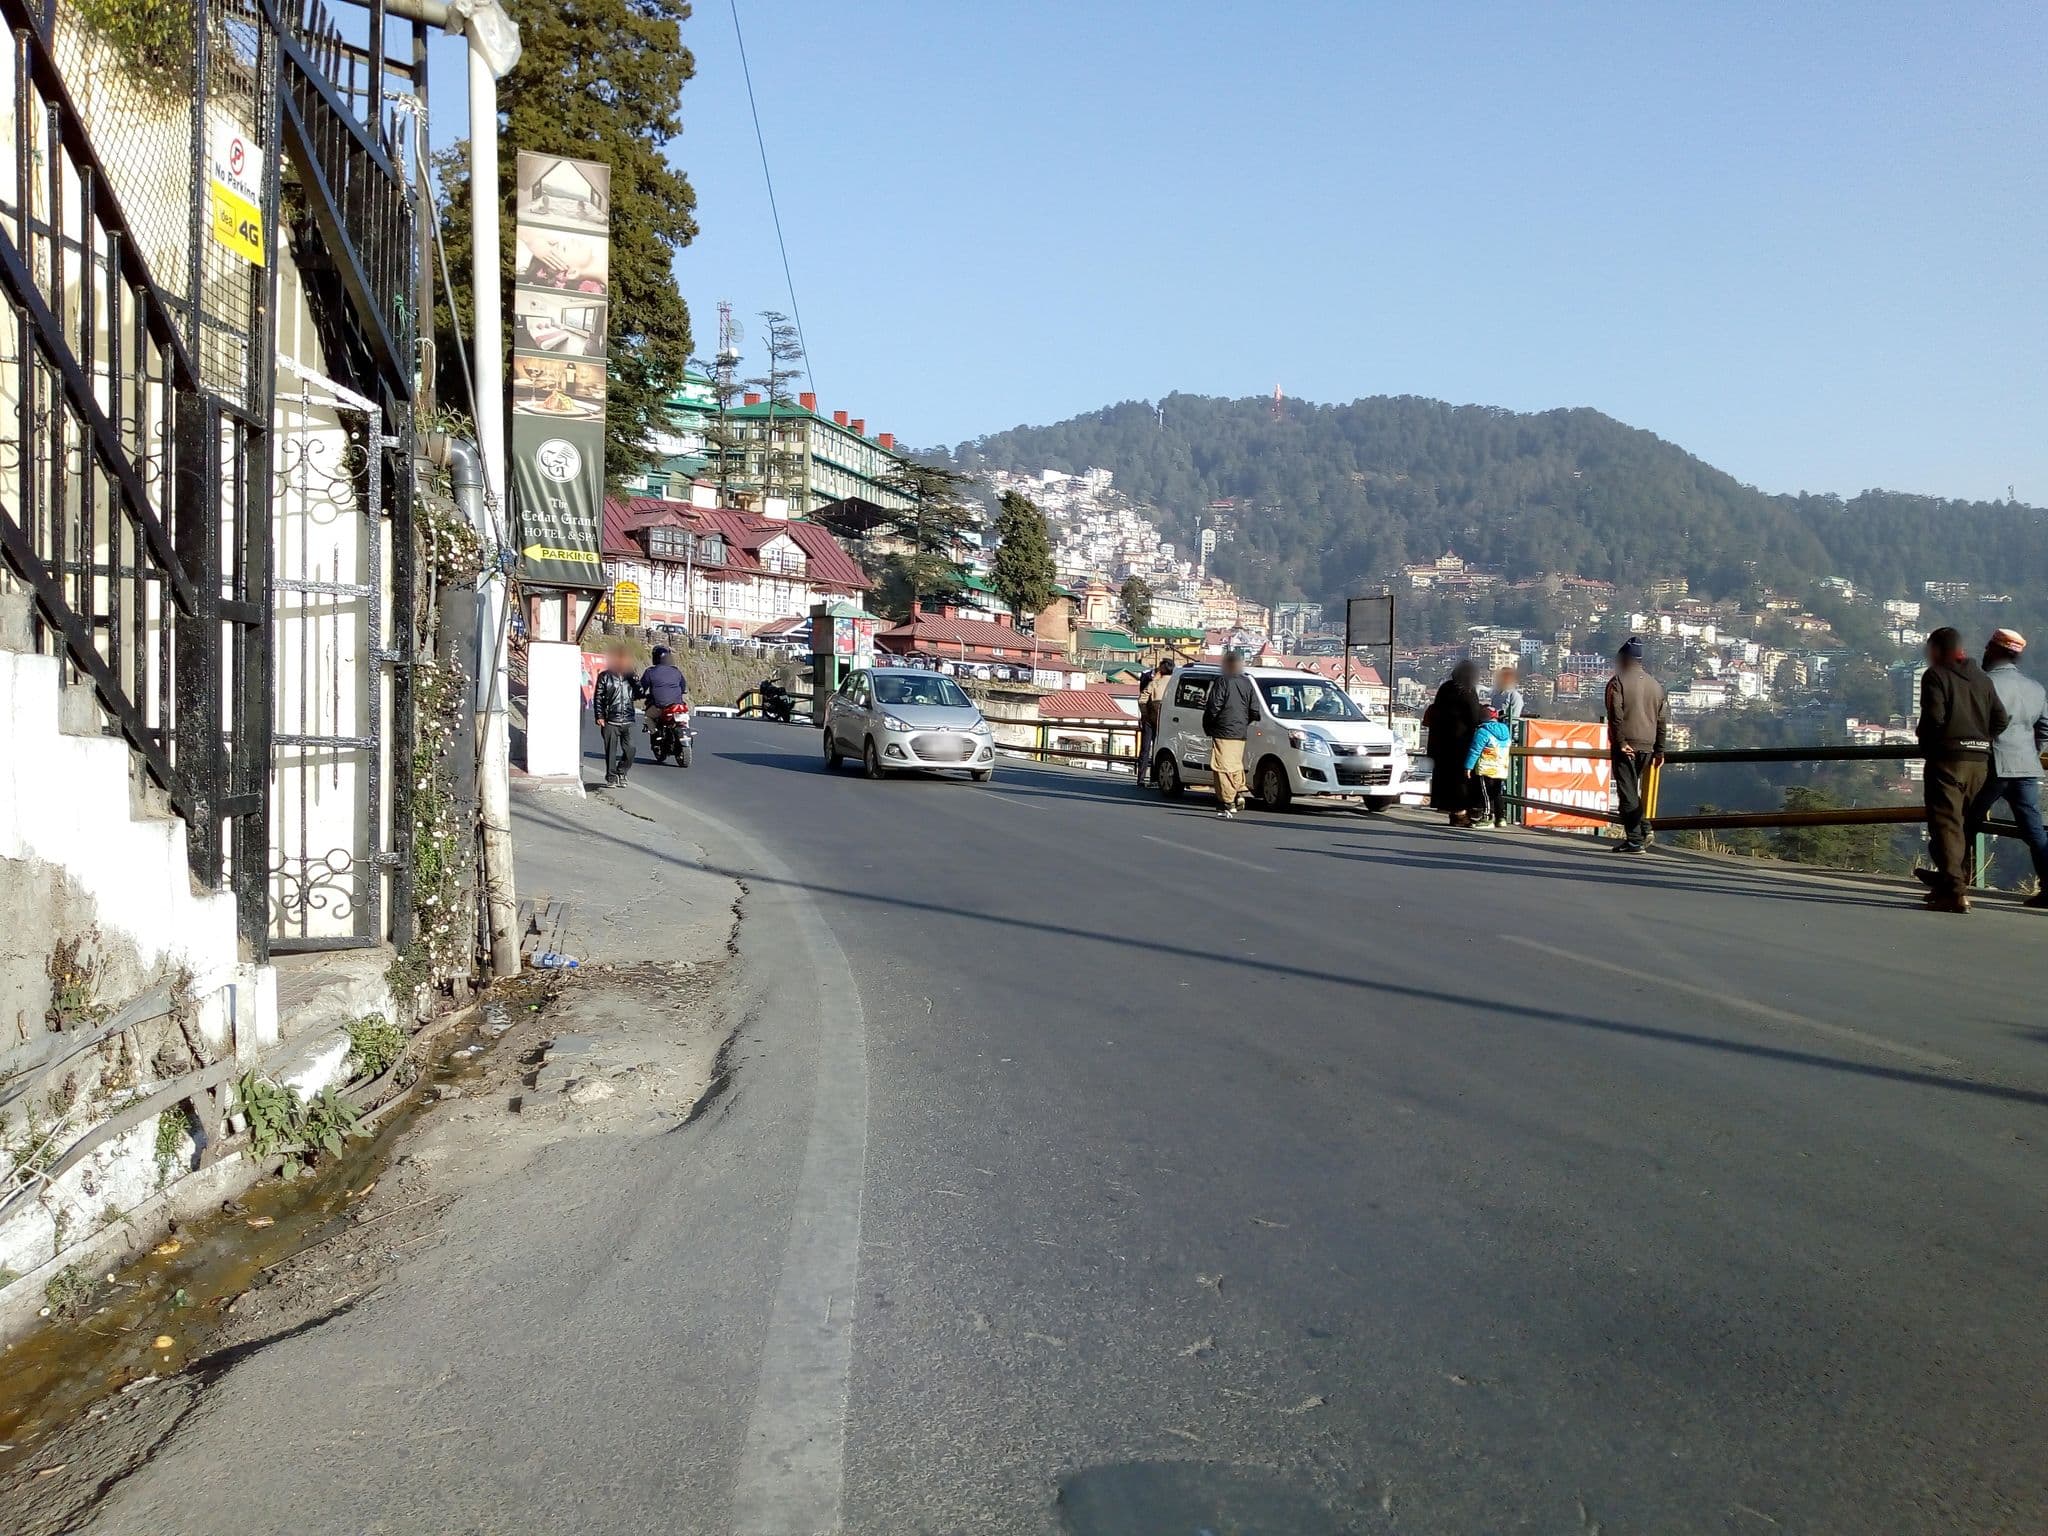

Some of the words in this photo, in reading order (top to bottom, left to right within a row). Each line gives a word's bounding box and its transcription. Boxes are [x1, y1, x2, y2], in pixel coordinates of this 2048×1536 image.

[215, 161, 225, 181] No
[227, 171, 256, 205] Parking
[239, 220, 259, 247] 4G
[551, 497, 568, 509] The
[521, 509, 557, 523] Cedar
[561, 511, 597, 527] Grand
[524, 527, 565, 539] HOTEL
[568, 531, 578, 540] &
[579, 532, 597, 542] SPA
[542, 549, 594, 561] PARKING
[1533, 738, 1593, 774] CAR
[1526, 787, 1608, 814] PARKING
